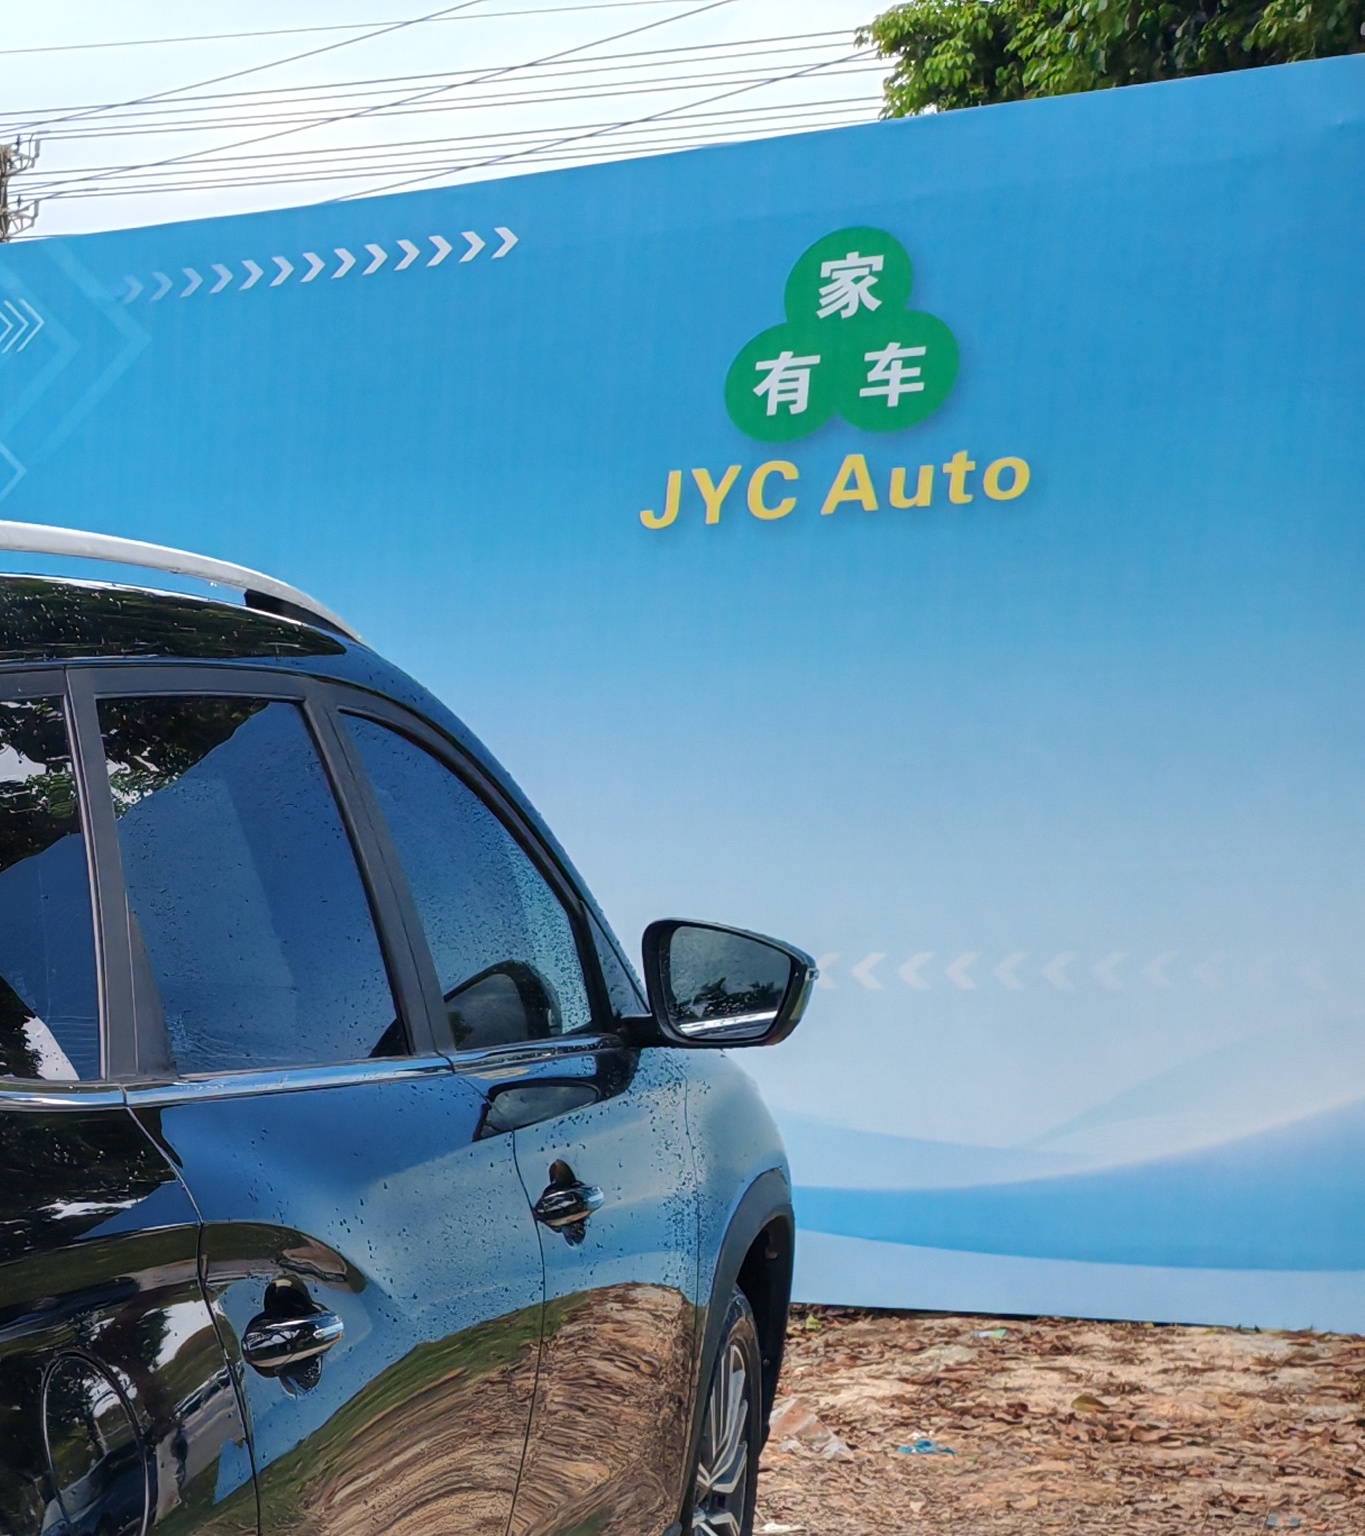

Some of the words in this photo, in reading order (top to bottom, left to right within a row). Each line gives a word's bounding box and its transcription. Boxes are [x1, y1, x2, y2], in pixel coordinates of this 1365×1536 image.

[816, 251, 885, 320] 家
[639, 460, 800, 530] JYC
[820, 450, 1031, 516] Auto
